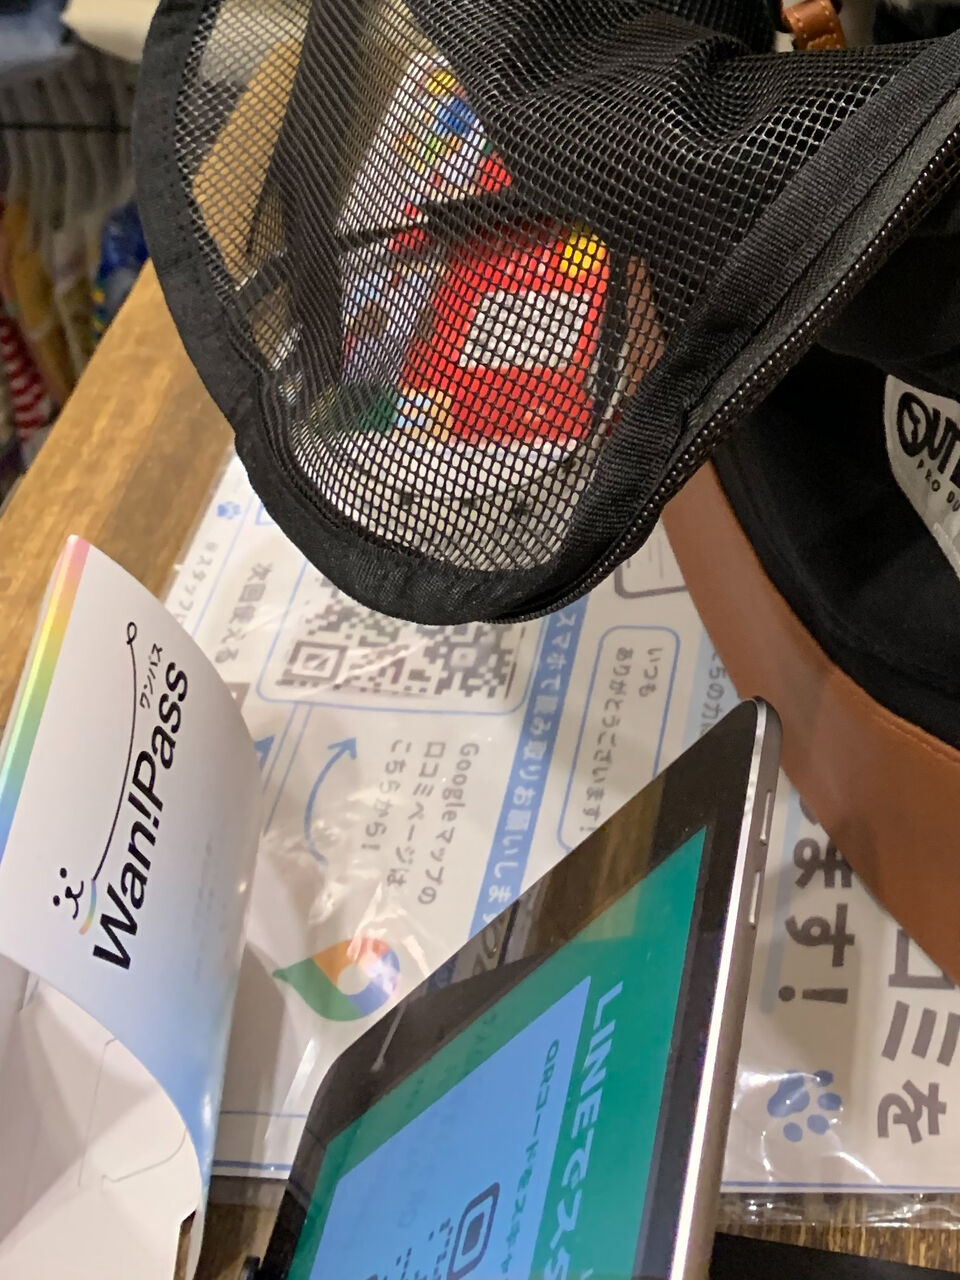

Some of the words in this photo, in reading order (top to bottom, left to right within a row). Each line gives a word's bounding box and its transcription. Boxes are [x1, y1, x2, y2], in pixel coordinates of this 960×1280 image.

[639, 646, 663, 698] いつも
[92, 662, 189, 971] Wan!Pass
